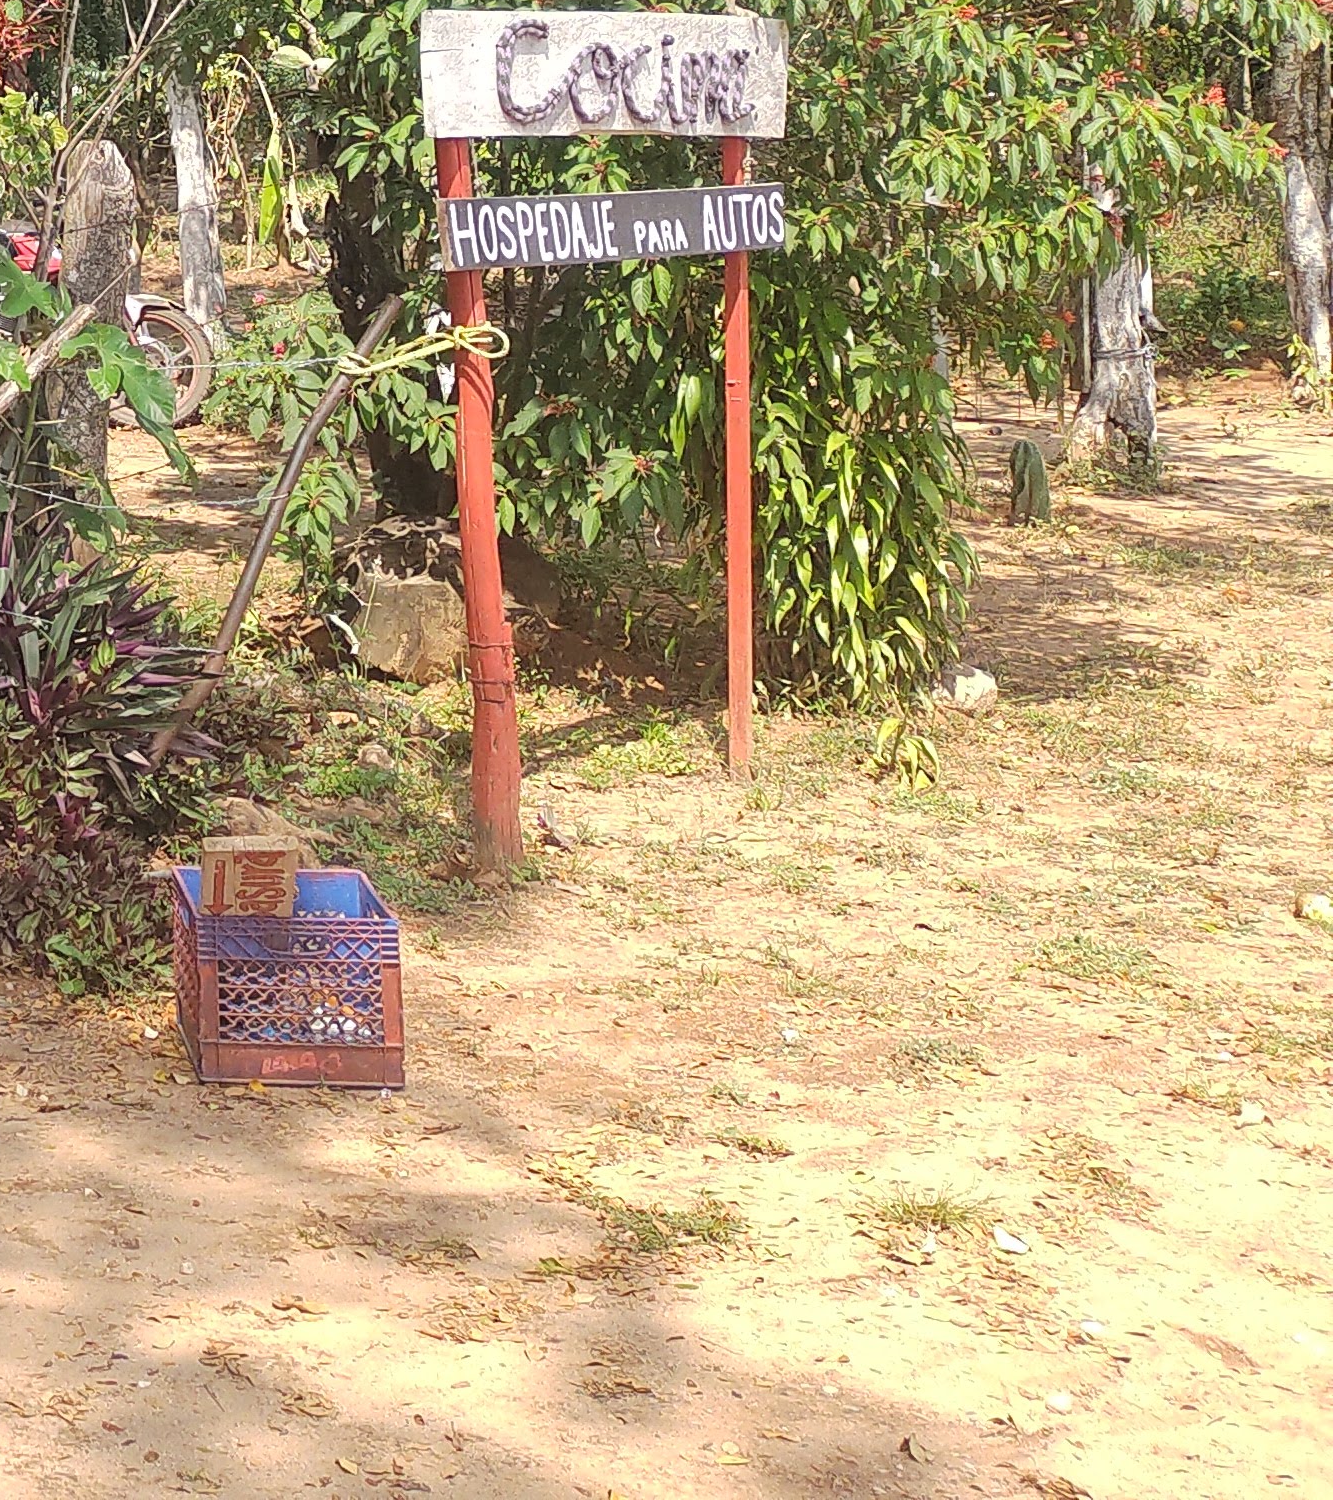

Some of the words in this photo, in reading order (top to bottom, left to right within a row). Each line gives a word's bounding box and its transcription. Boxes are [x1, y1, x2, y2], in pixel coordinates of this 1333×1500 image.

[496, 18, 755, 125] Cocina
[449, 200, 619, 267] HOSPEDAJE
[633, 218, 689, 254] PARA
[702, 191, 785, 252] AUTOS
